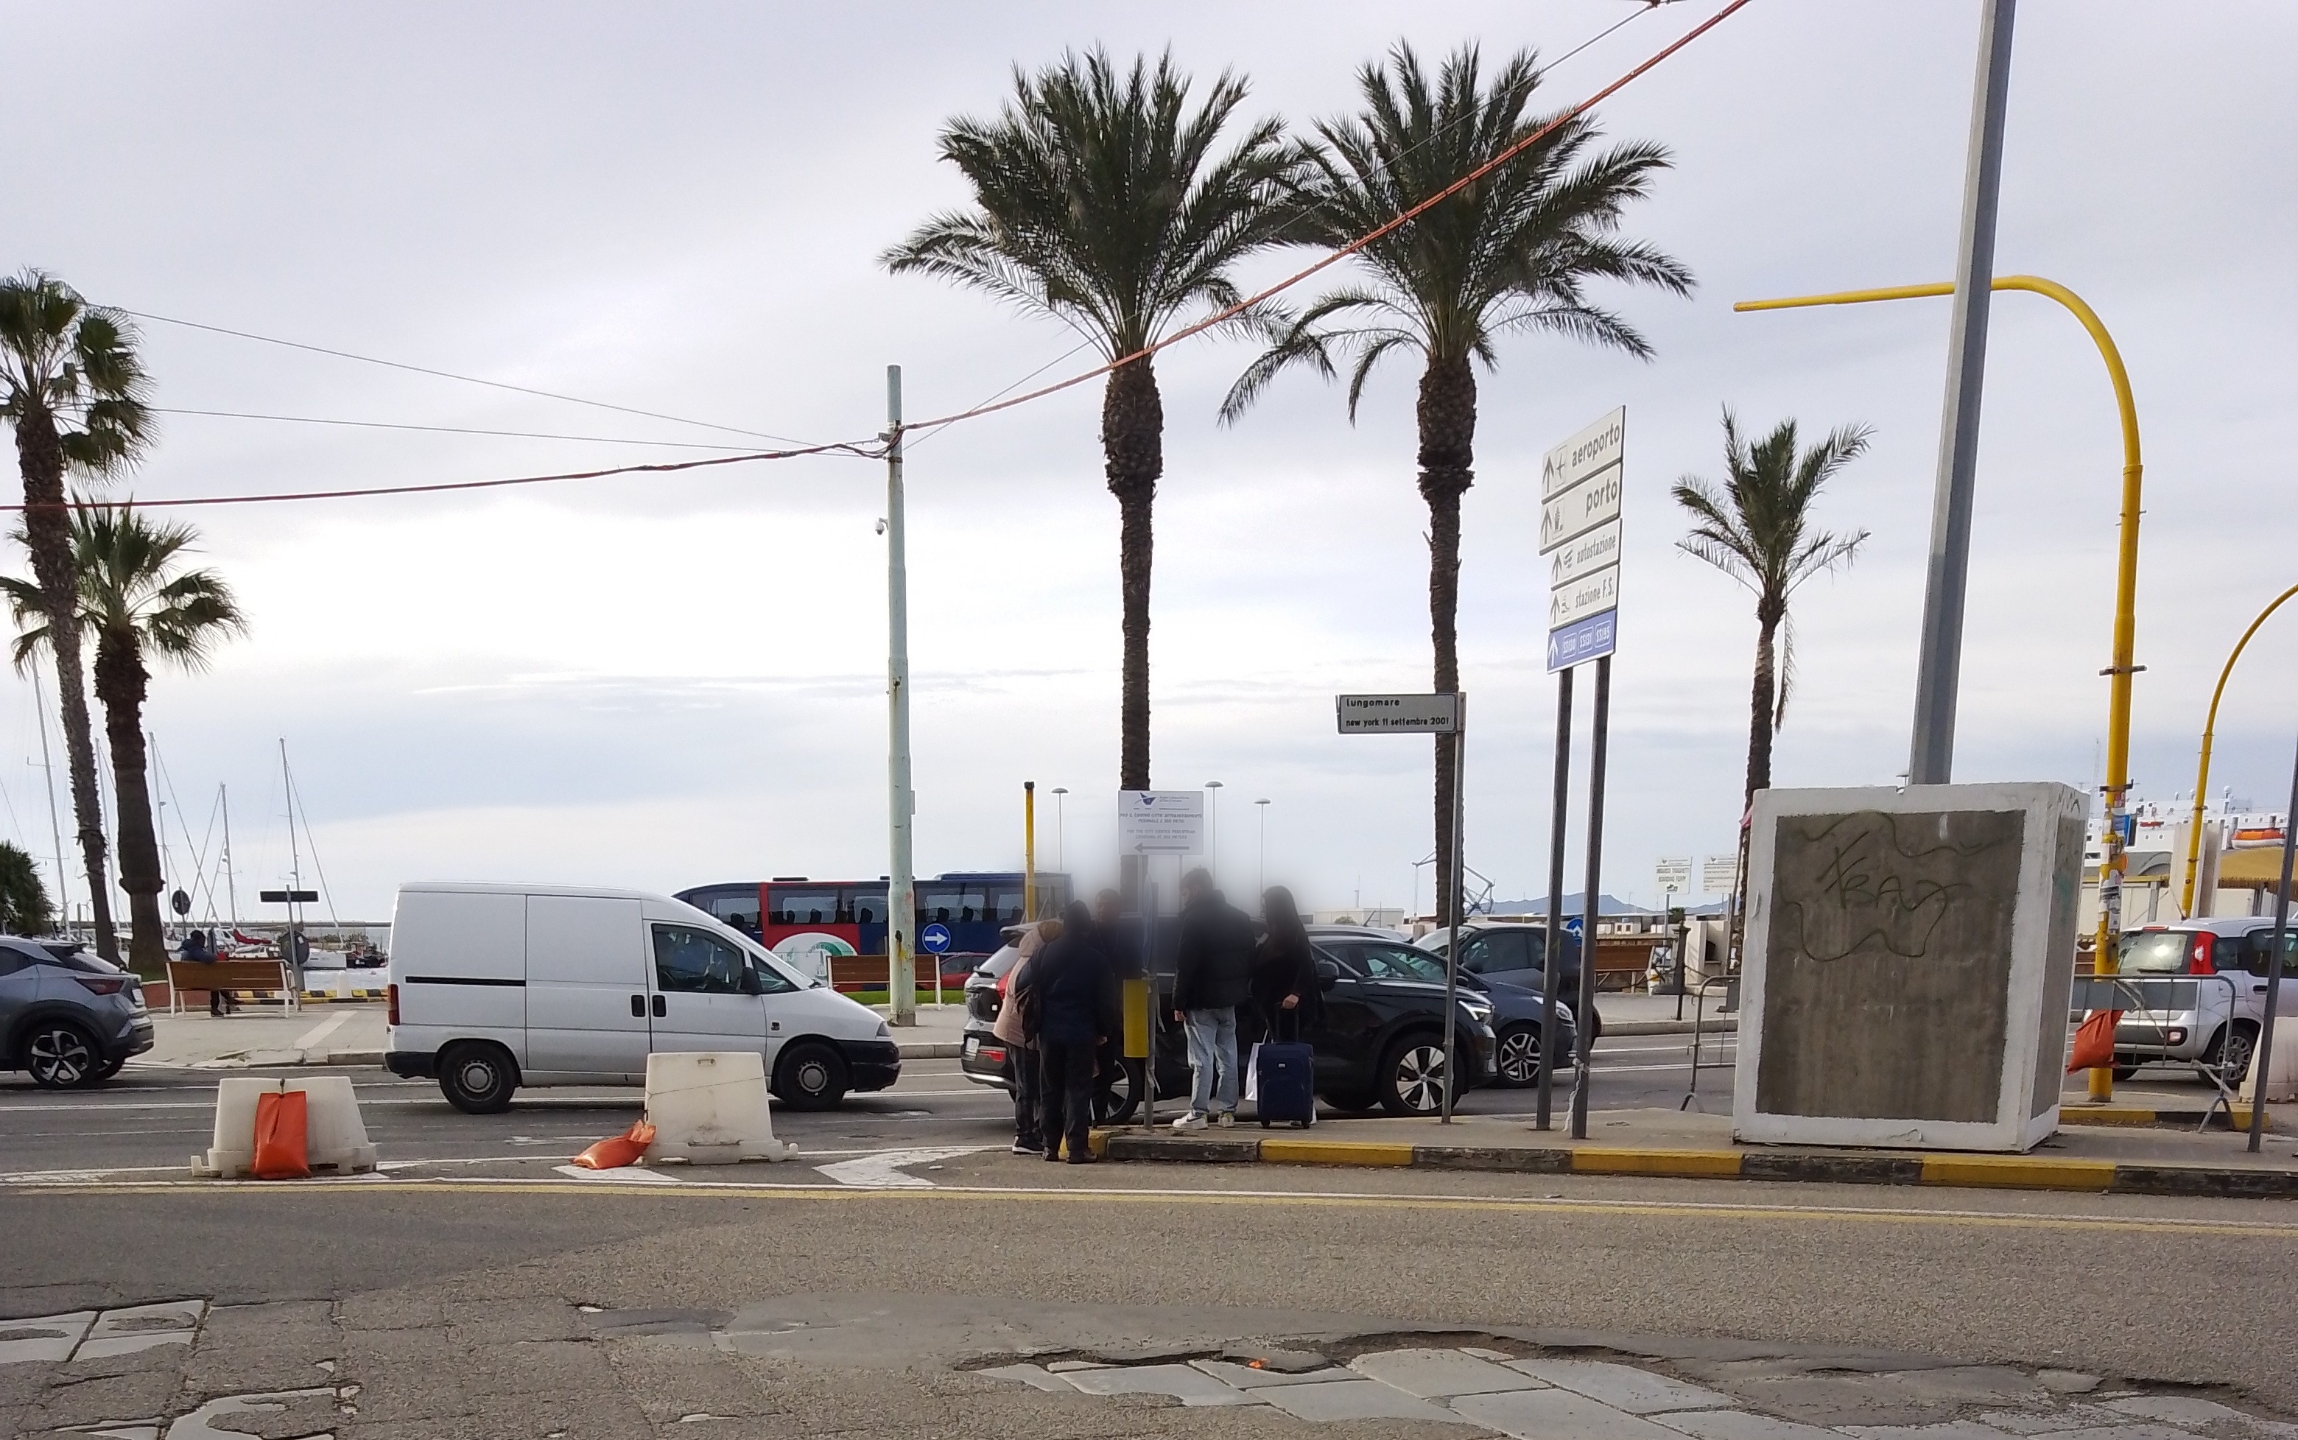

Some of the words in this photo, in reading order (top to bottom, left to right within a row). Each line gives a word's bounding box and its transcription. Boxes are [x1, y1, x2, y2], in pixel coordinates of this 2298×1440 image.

[1571, 423, 1620, 468] aeroporto
[1585, 478, 1618, 518] porto
[1576, 534, 1616, 564] autostazione
[1575, 585, 1601, 609] stazione
[1602, 576, 1615, 599] F.S.
[1363, 718, 1379, 728] york
[1382, 718, 1388, 726] 11
[1391, 717, 1428, 726] settembre
[1430, 717, 1449, 725] 2001
